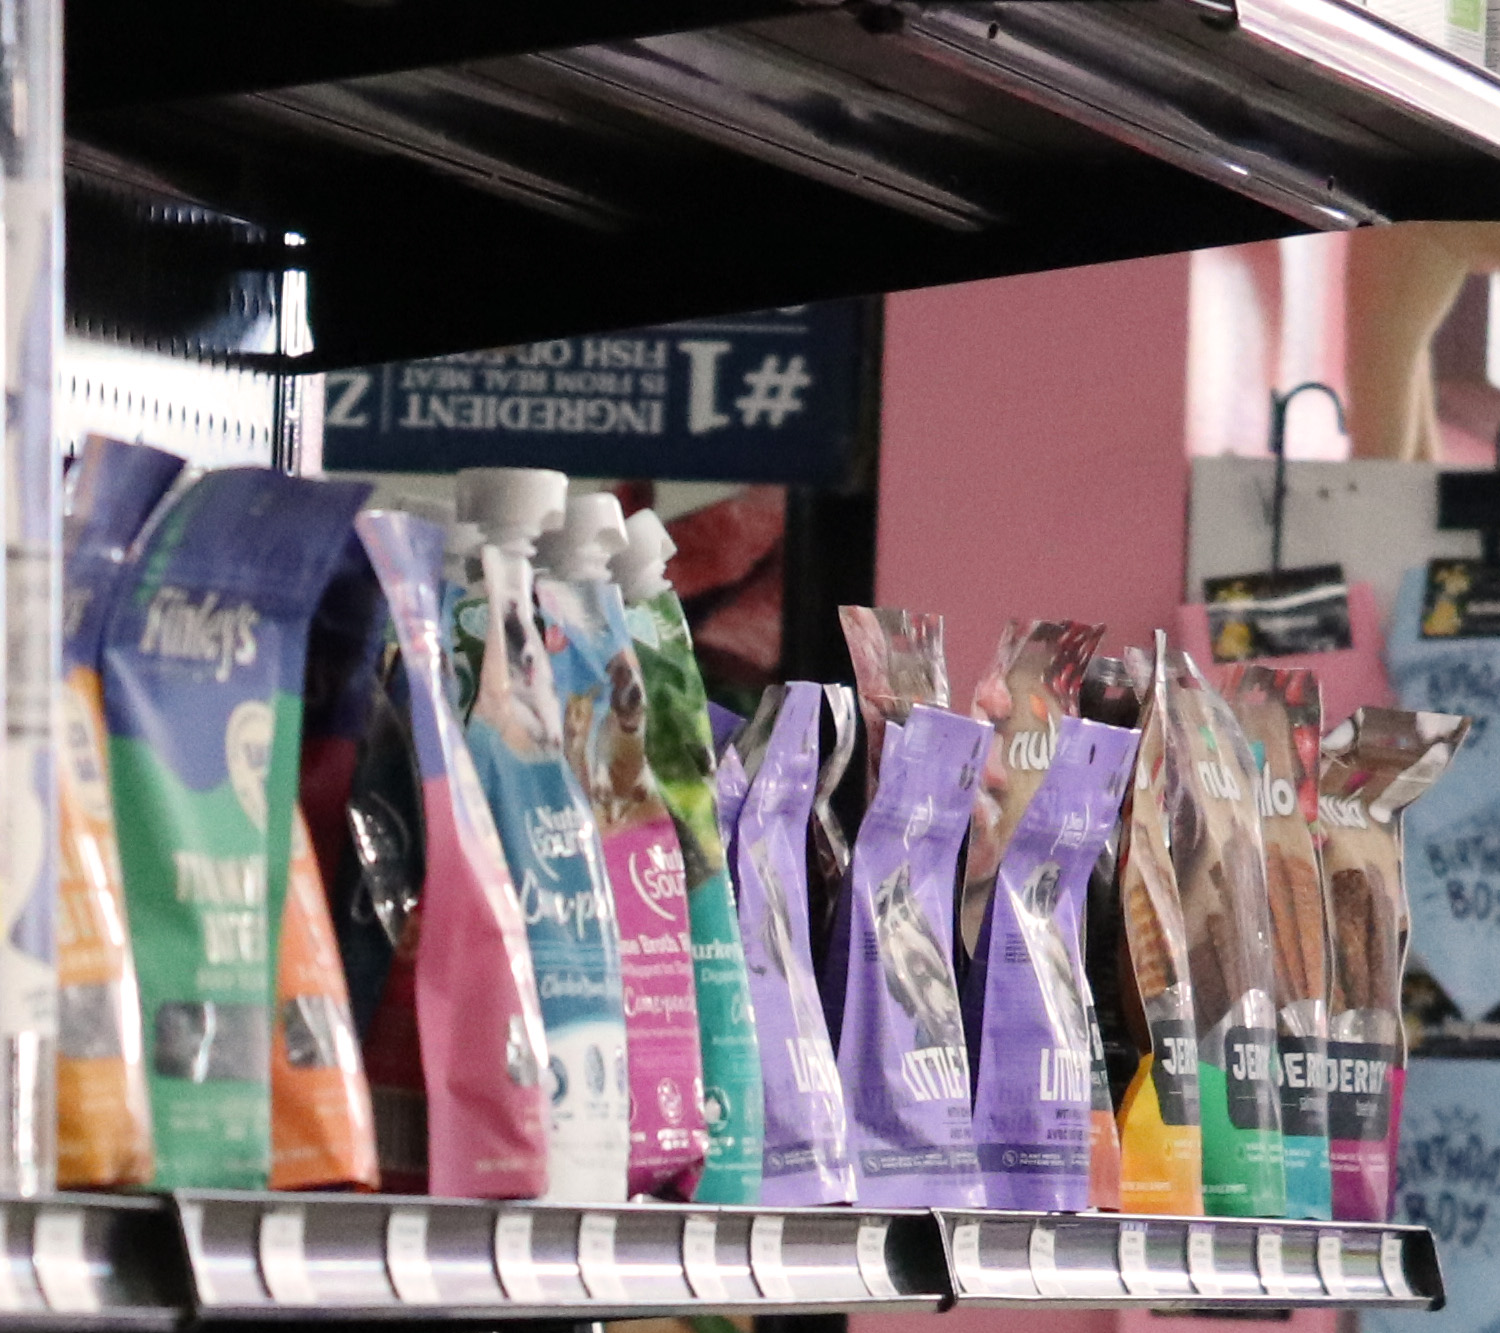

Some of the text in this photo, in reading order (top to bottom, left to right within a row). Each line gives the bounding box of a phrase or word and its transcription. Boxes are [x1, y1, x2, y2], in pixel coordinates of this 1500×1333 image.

[584, 340, 667, 368] FISH
[402, 368, 473, 391] MEAT
[485, 369, 546, 393] REAL
[553, 369, 638, 393] FROM
[400, 396, 666, 434] INGREDIENT
